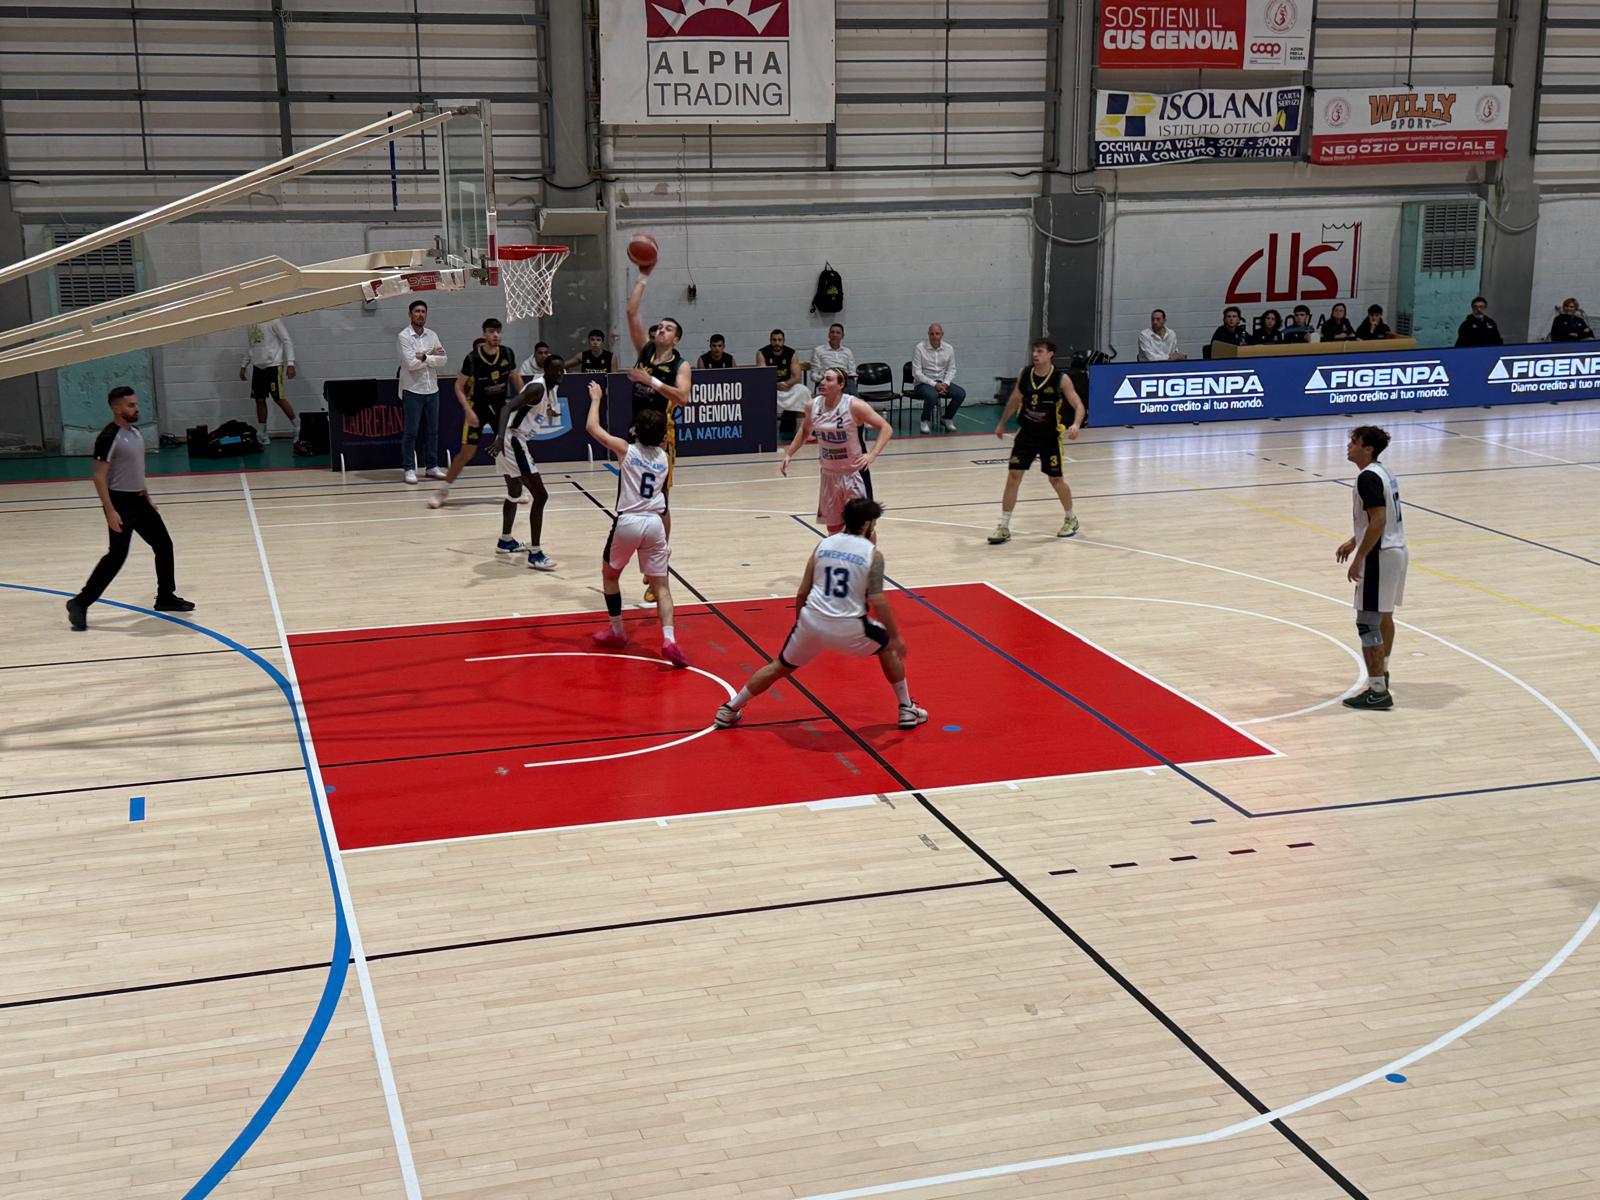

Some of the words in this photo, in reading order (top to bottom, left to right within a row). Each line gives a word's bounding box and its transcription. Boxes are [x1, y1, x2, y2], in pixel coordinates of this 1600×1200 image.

[1105, 6, 1199, 28] SOSTIENI
[1206, 7, 1222, 28] IL
[1103, 29, 1146, 50] CUS
[1150, 29, 1239, 50] GENOVA
[1250, 42, 1281, 57] coop
[654, 51, 782, 74] ALPHA
[653, 83, 783, 106] TRADING
[1159, 91, 1273, 121] ISOLANI
[1369, 93, 1457, 126] WILLY
[1159, 123, 1220, 137] ISTITUTO
[1223, 121, 1271, 136] OTTICO
[1391, 118, 1432, 130] SPORT
[1099, 142, 1152, 153] OCCHIALI
[1154, 140, 1172, 151] DA
[1175, 137, 1206, 149] VISTA
[1217, 138, 1247, 148] SOLE
[1256, 136, 1294, 148] SPORT
[1321, 143, 1400, 155] NEGOZIO
[1405, 141, 1496, 152] UFFICIALE
[1099, 153, 1135, 165] LENTI
[1139, 152, 1148, 163] A
[1151, 146, 1216, 161] CONTATTO
[1219, 147, 1237, 158] SU
[1241, 148, 1293, 159] MISURA
[1330, 365, 1450, 388] FIGENPA
[1511, 382, 1538, 393] Diamo
[1539, 379, 1568, 392] credito
[1569, 379, 1577, 390] al
[1578, 380, 1593, 389] tuo
[1140, 375, 1264, 398] FIGENPA
[1329, 392, 1358, 404] Diamo
[1359, 390, 1388, 402] credito
[1390, 389, 1398, 400] al
[1400, 389, 1415, 399] tuo
[1417, 386, 1449, 398] mondo.
[1031, 394, 1038, 405] 3
[1140, 402, 1169, 414] Diamo
[1170, 400, 1201, 412] credito
[1202, 399, 1211, 411] al
[1213, 400, 1228, 410] tuo
[1230, 397, 1264, 409] mondo.
[342, 404, 404, 438] LAURETAN
[684, 405, 696, 424] DI
[698, 403, 743, 423] GENOVA
[836, 416, 844, 429] 2
[679, 427, 693, 441] LA
[696, 425, 743, 440] NATURA!
[1049, 455, 1059, 467] 3
[640, 472, 656, 499] 6
[824, 565, 850, 599] 13
